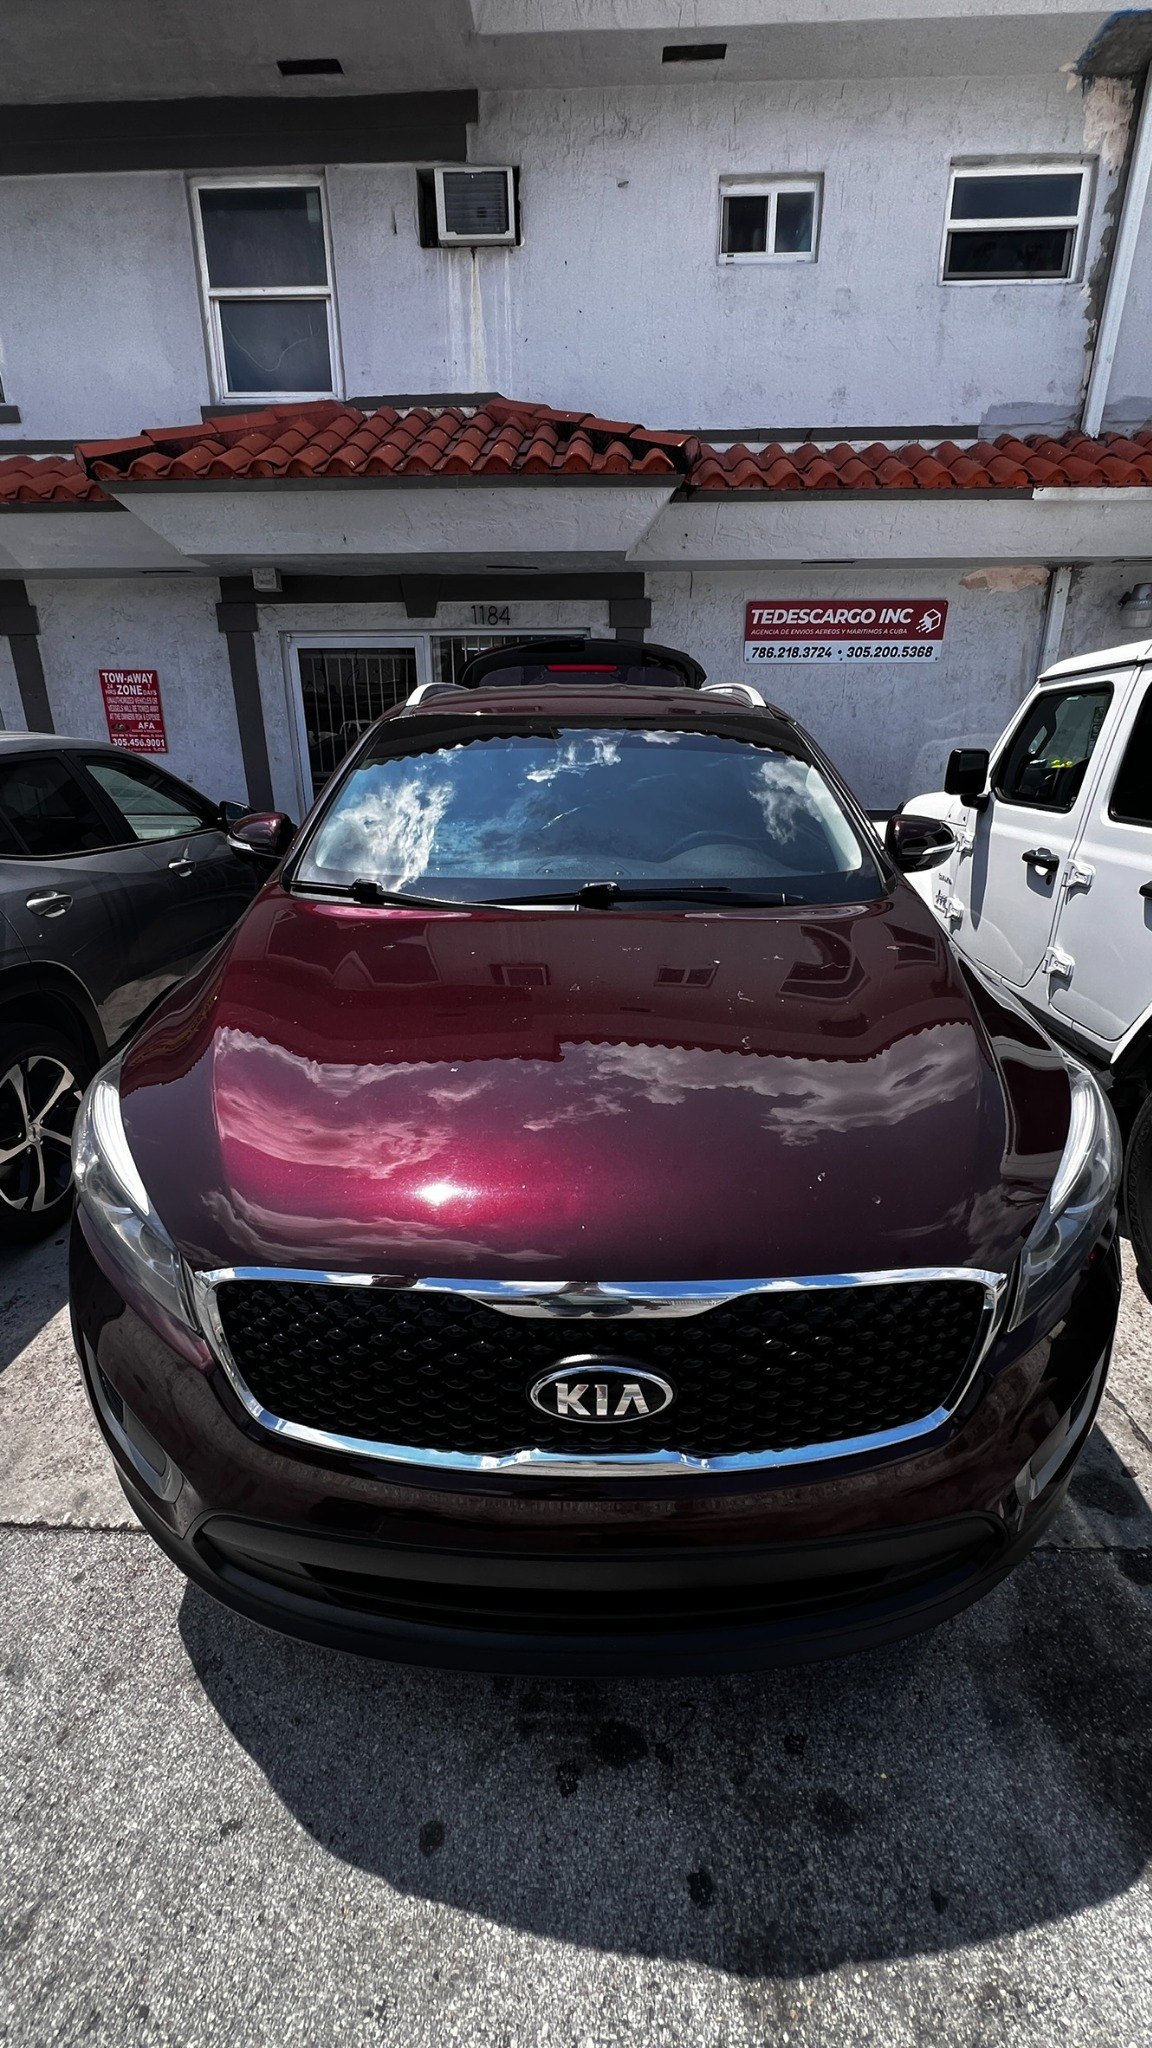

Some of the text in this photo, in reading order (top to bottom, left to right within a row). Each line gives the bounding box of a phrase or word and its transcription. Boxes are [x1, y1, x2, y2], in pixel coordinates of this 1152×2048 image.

[471, 605, 511, 626] 1184
[751, 608, 914, 625] TEDESCARGO INC
[751, 628, 780, 636] AGENCIA
[751, 646, 934, 659] 786.218.3724 305.200.5368
[102, 672, 153, 684] TOW-AWAY
[116, 684, 143, 696] ZONE
[138, 722, 155, 730] AFA
[112, 738, 165, 747] 305.456.9001
[555, 1382, 650, 1416] KIA
